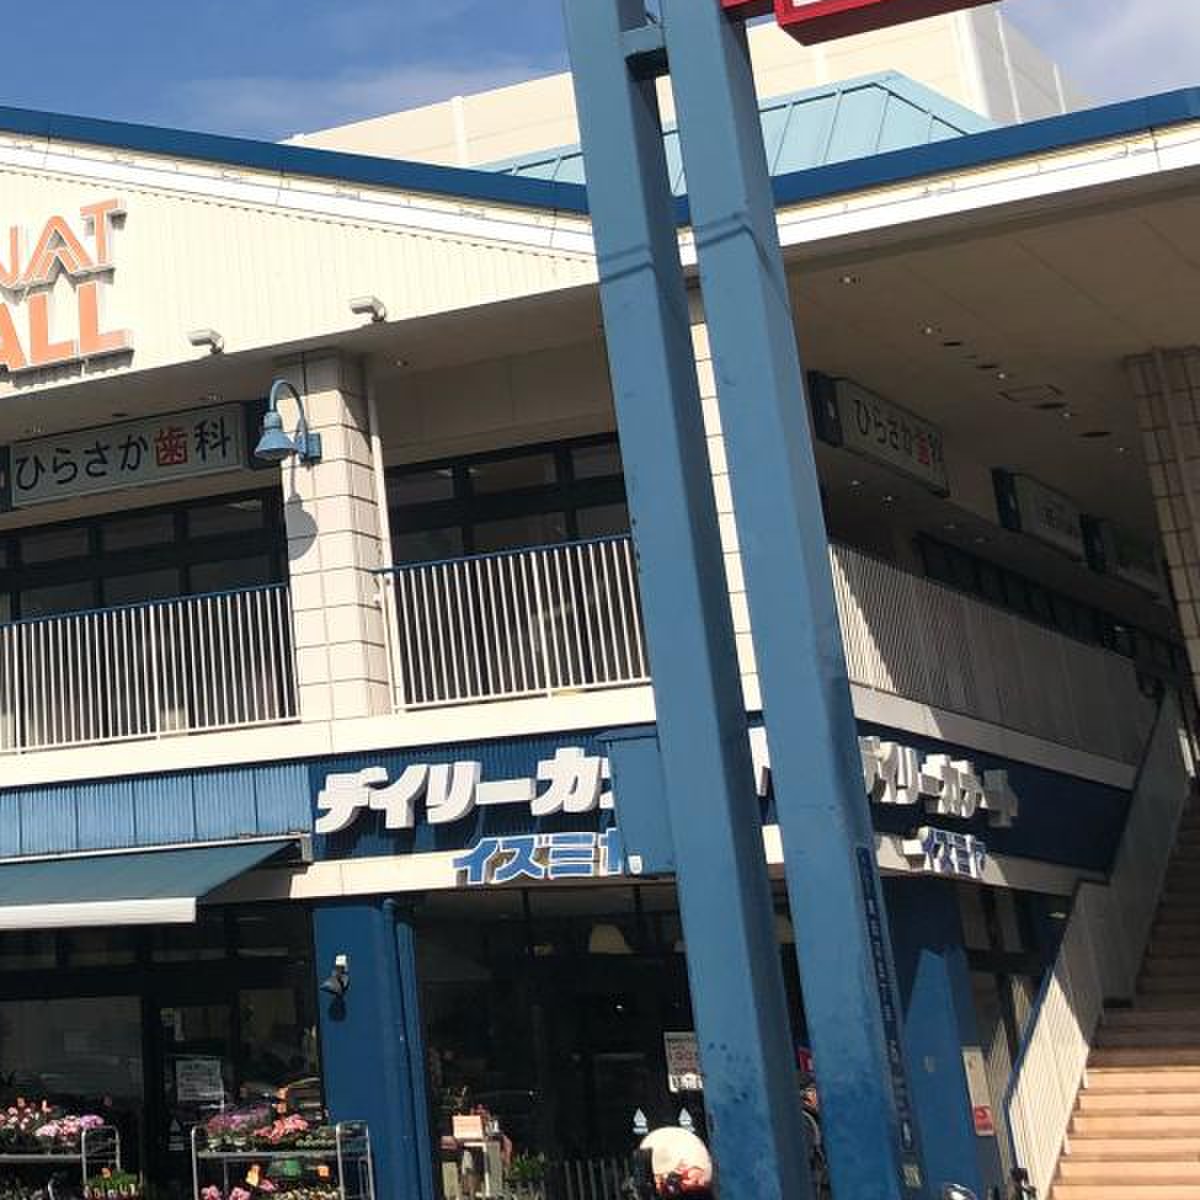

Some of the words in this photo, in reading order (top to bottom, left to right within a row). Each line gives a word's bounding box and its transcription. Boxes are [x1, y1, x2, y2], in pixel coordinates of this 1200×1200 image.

[15, 416, 232, 491] ひらさか歯科
